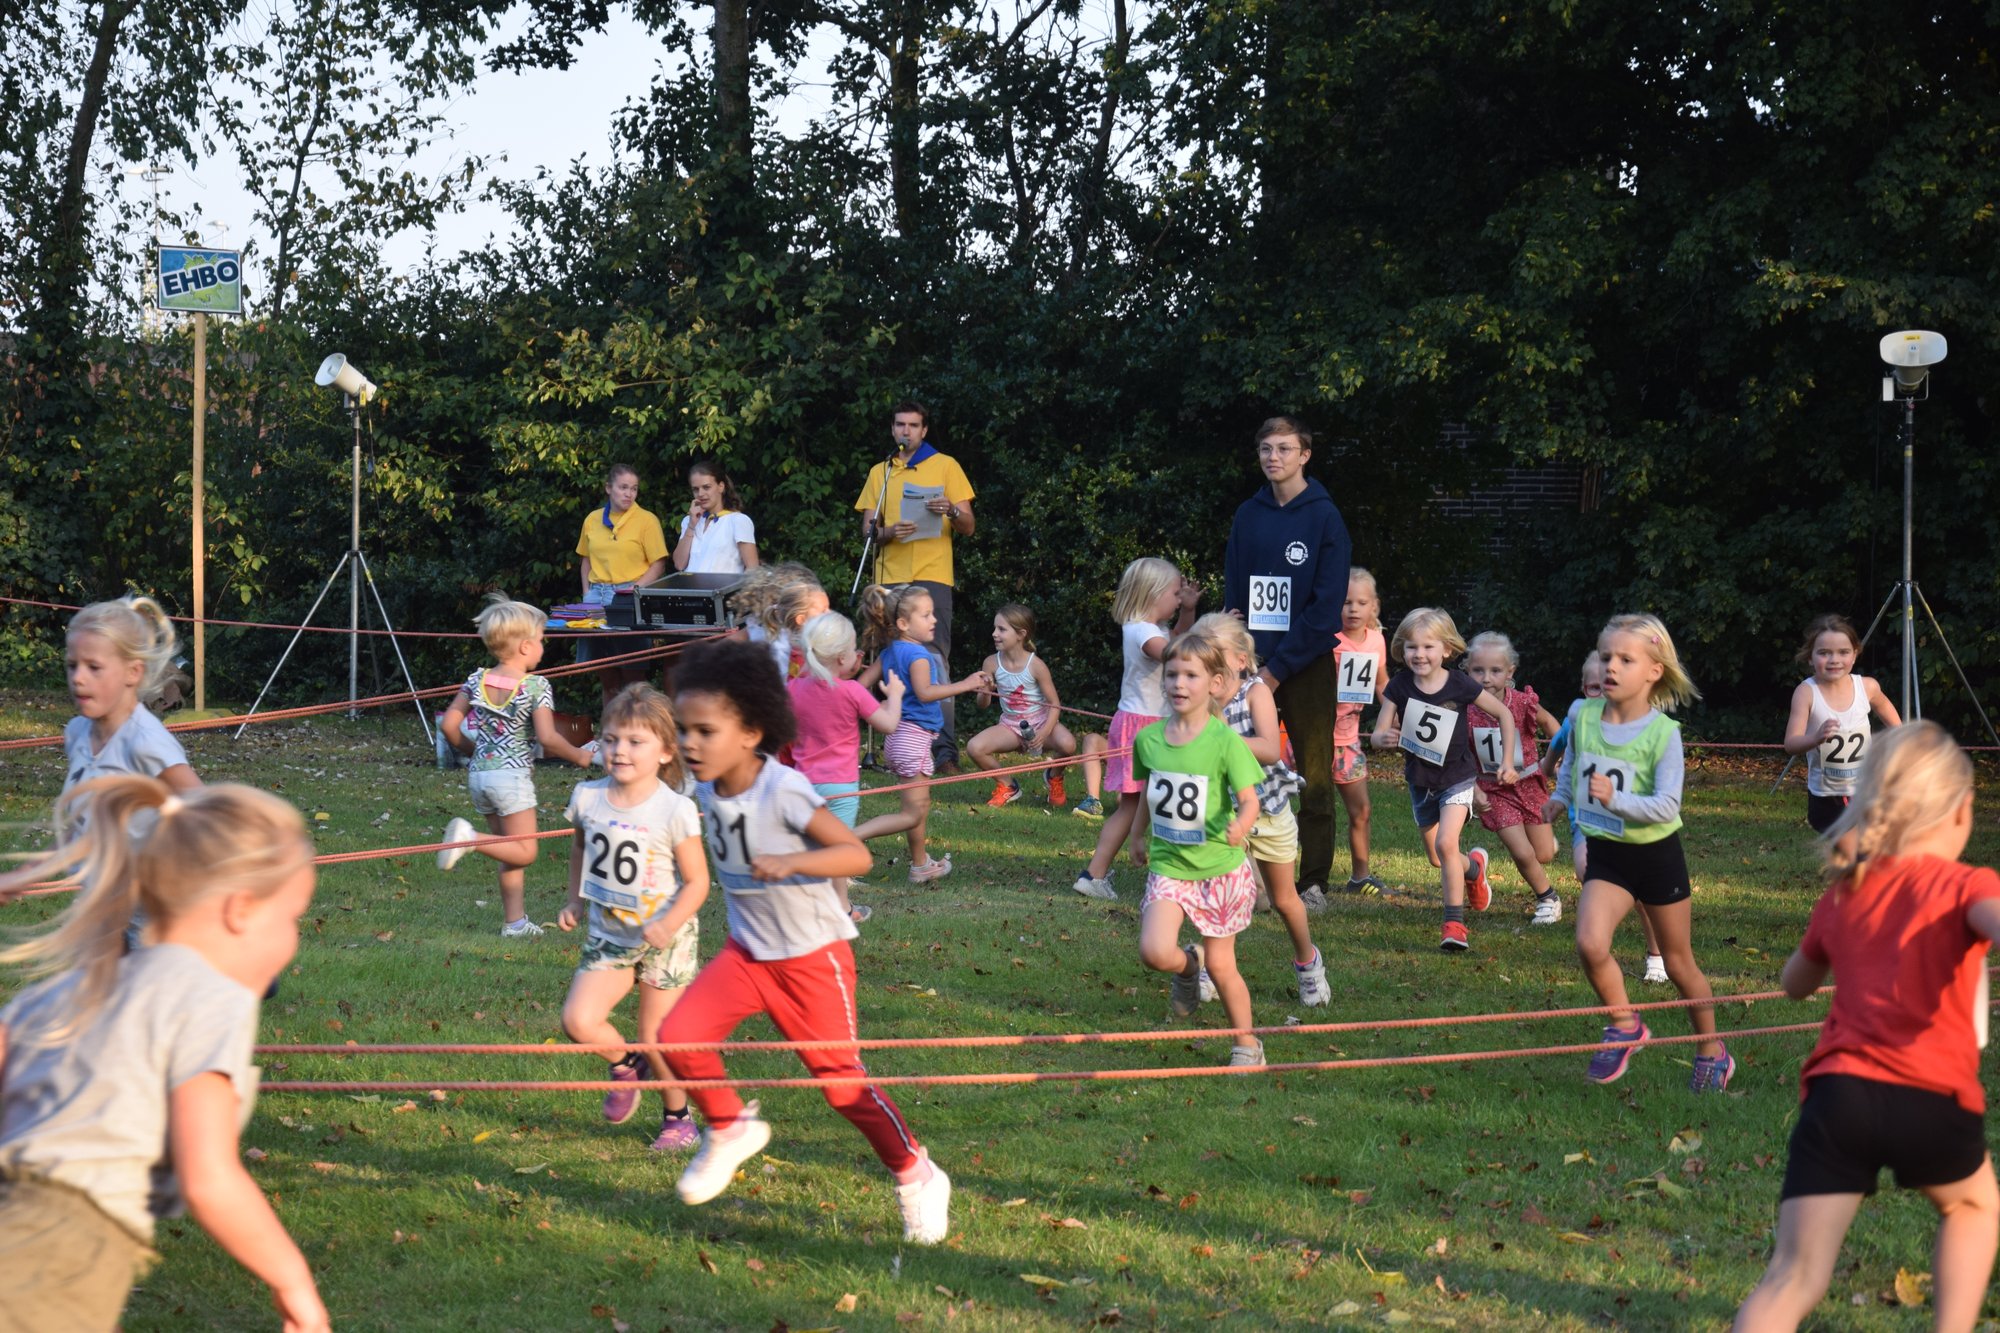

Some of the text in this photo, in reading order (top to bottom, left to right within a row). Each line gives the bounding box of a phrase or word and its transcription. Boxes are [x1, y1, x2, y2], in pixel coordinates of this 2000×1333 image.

[163, 261, 239, 296] EHBO
[1253, 581, 1289, 612] 396
[1344, 658, 1373, 687] 14
[1415, 711, 1441, 743] 5
[1825, 733, 1865, 763] 22
[1155, 778, 1199, 821] 28
[711, 808, 753, 866] 31
[590, 832, 640, 886] 26
